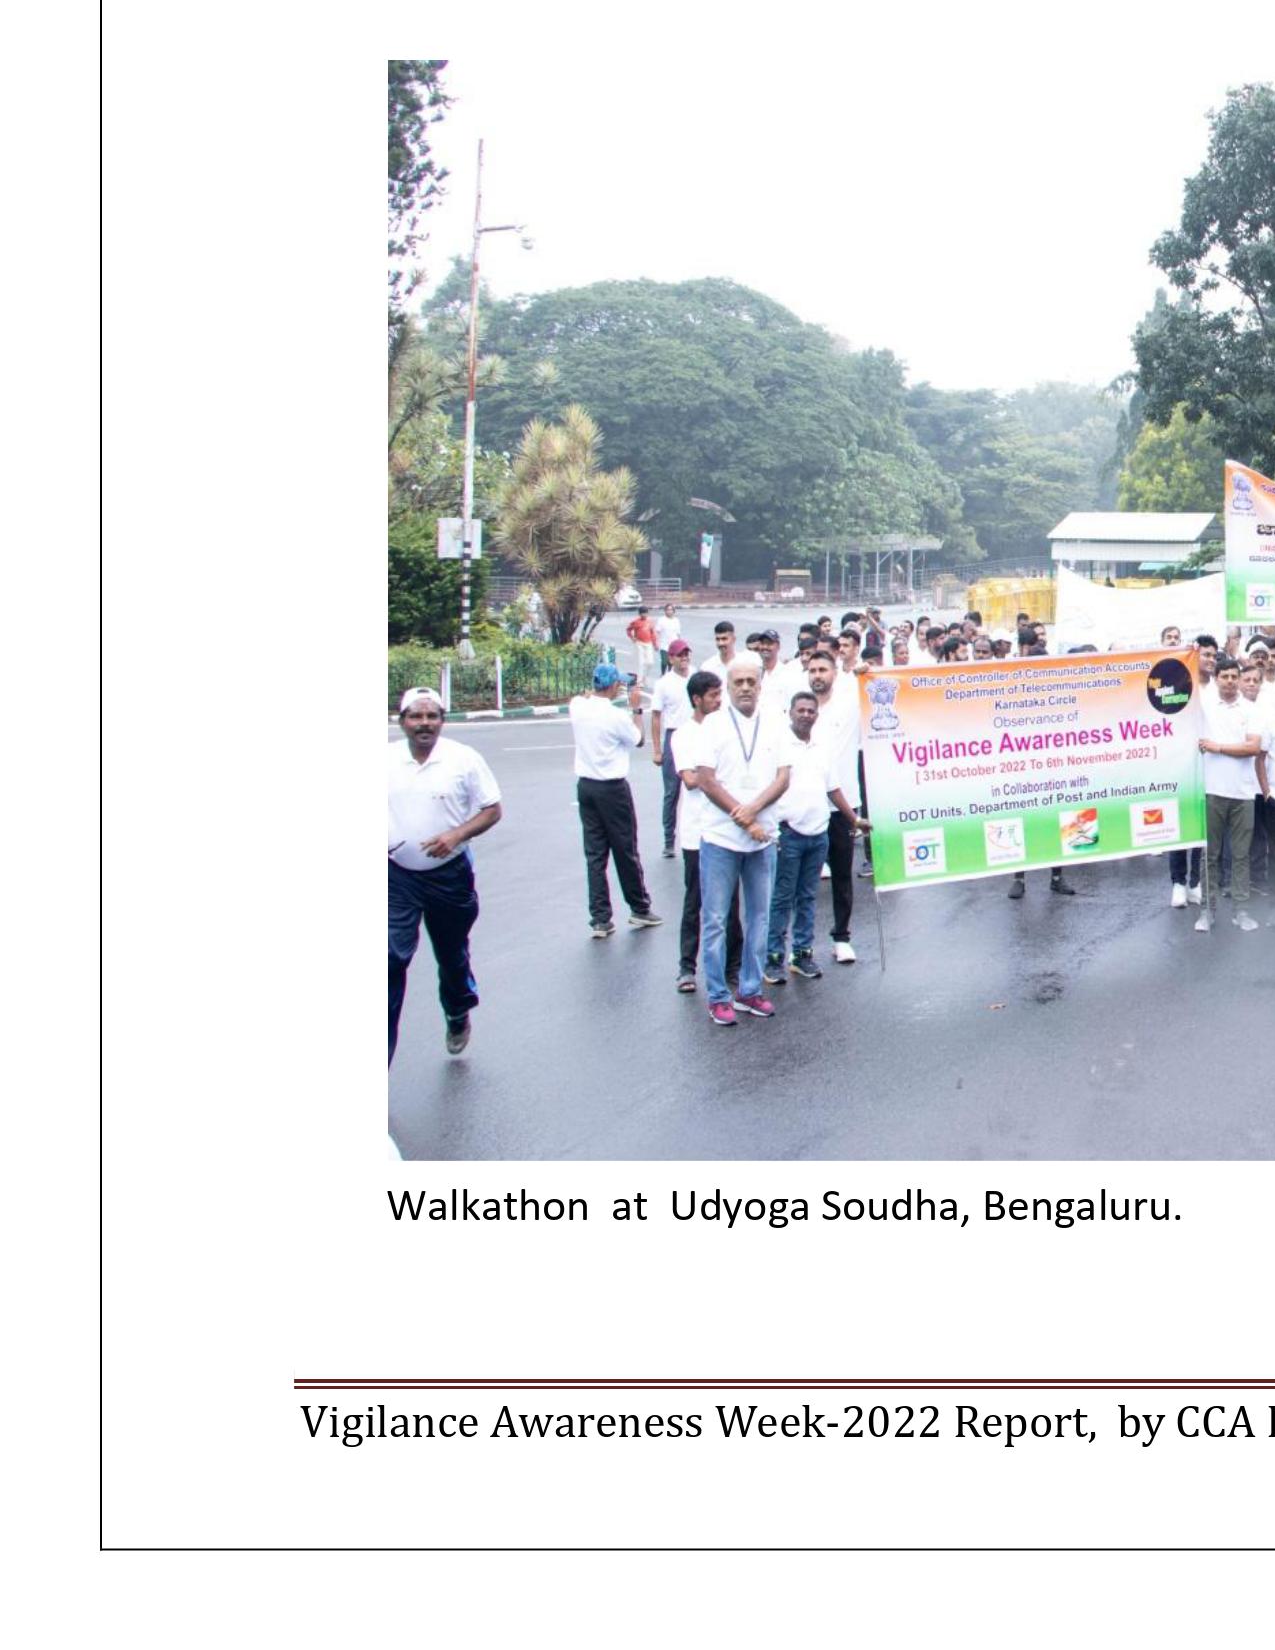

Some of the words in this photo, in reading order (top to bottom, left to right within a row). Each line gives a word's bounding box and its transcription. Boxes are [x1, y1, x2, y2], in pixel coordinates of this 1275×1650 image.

[911, 676, 942, 688] Office
[958, 671, 1009, 685] Controller
[1025, 665, 1103, 680] Communication
[1105, 661, 1151, 673] Accounts
[945, 688, 1005, 702] Department
[1021, 677, 1122, 694] Telecommunications
[995, 698, 1046, 711] Karnataka
[1048, 694, 1077, 706] Circle
[993, 713, 1064, 729] Observance
[1067, 711, 1079, 722] of
[892, 738, 993, 767] Vigilance
[999, 727, 1113, 753] Awareness
[1118, 717, 1174, 741] Week
[923, 769, 948, 783] 31st
[951, 765, 997, 779] October
[1000, 760, 1026, 774] 2022
[1030, 758, 1043, 770] To
[1046, 756, 1063, 769] 6th
[1067, 751, 1122, 767] November
[1125, 748, 1151, 760] 2022
[991, 785, 1001, 797] in
[1003, 777, 1068, 796] Collaboration
[1070, 775, 1089, 788] with
[899, 809, 927, 823] DOT
[969, 797, 1039, 815] Department
[1042, 794, 1055, 807] of
[1057, 791, 1087, 804] Post
[1087, 787, 1108, 801] and
[1111, 784, 1146, 797] Indian
[1149, 781, 1179, 793] Army
